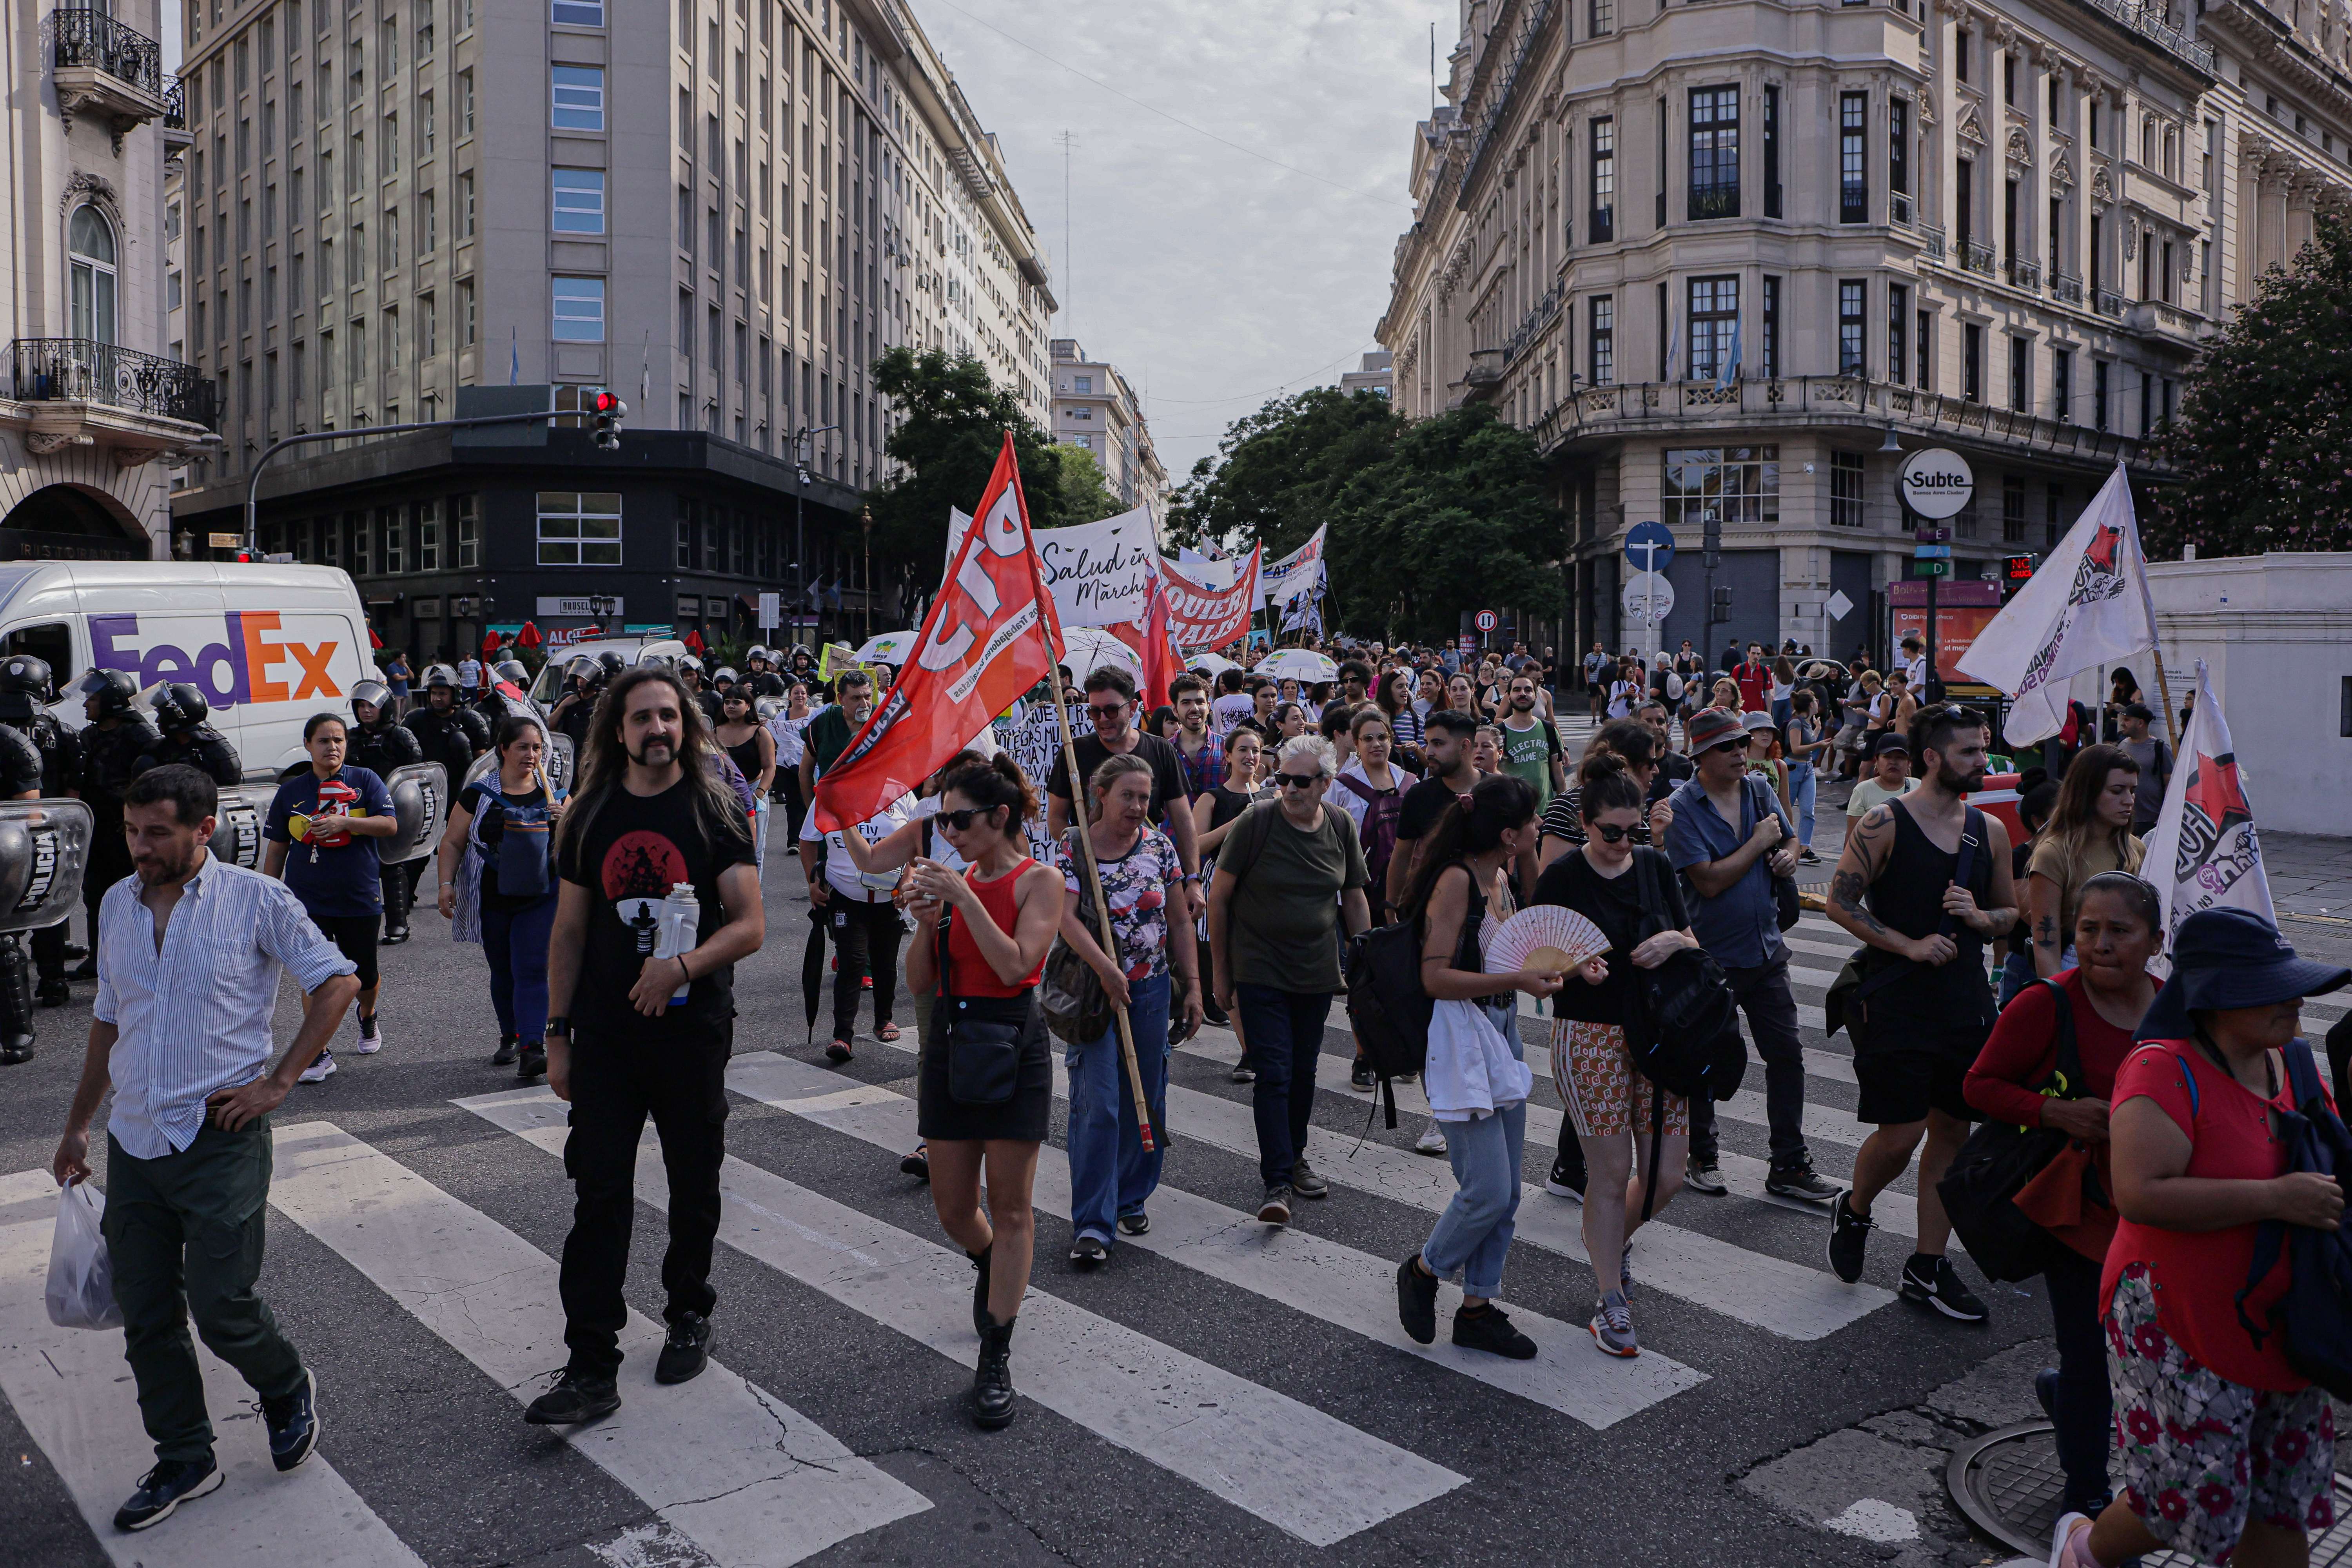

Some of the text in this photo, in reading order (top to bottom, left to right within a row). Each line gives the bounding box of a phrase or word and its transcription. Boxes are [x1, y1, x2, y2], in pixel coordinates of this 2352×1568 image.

[1913, 471, 1965, 487] Subte
[1936, 529, 1942, 539] E
[21, 543, 130, 561] RISTORANTE
[1934, 546, 1944, 556] A
[1042, 542, 1126, 586] Salud
[1130, 552, 1150, 566] en
[1934, 563, 1942, 573] D
[563, 601, 589, 610] BRUSEL
[87, 610, 343, 711] FedEx
[1508, 739, 1549, 757] ELECTRIC
[552, 751, 562, 779] LICIA
[1514, 752, 1537, 763] GAME
[859, 825, 878, 836] Fly
[20, 831, 55, 907] POLICIA
